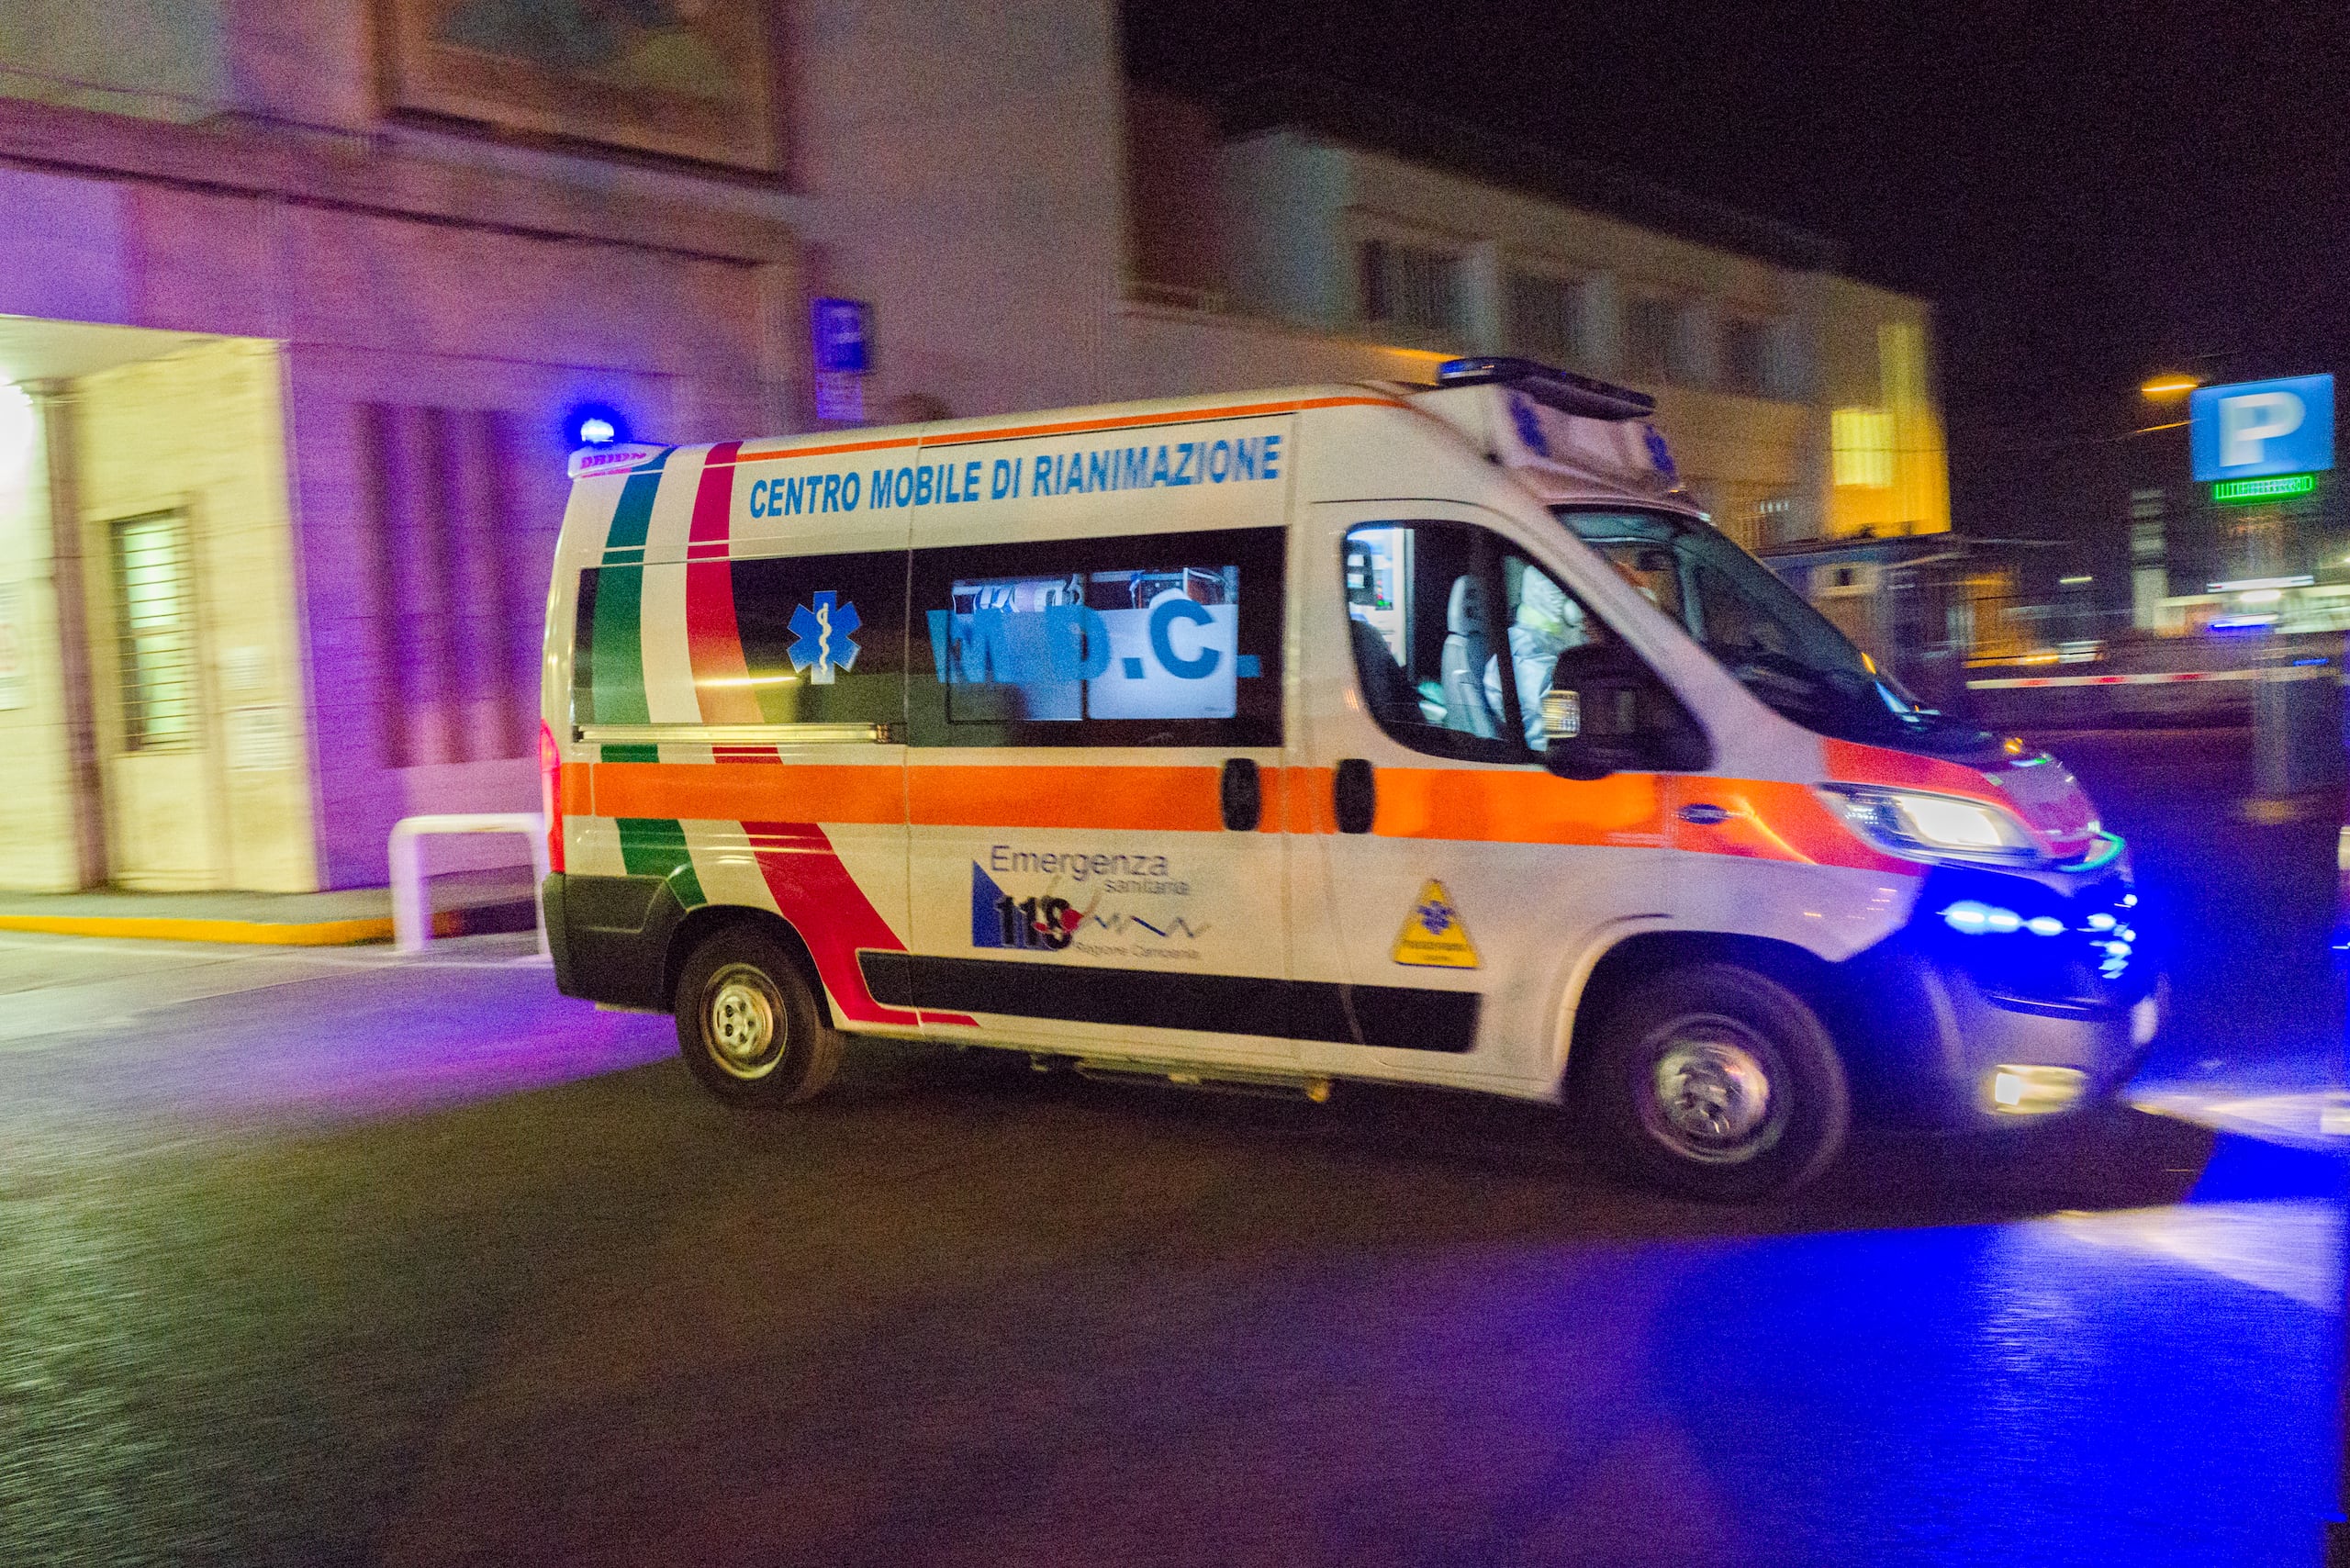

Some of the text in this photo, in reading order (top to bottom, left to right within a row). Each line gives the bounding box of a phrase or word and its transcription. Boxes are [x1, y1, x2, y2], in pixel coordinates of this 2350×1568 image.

[2218, 391, 2306, 467] P
[750, 434, 1282, 518] CENTRO MOBILE DI RIANIMAZIONE
[990, 845, 1169, 881] Emergenza
[995, 895, 1073, 950] 118
